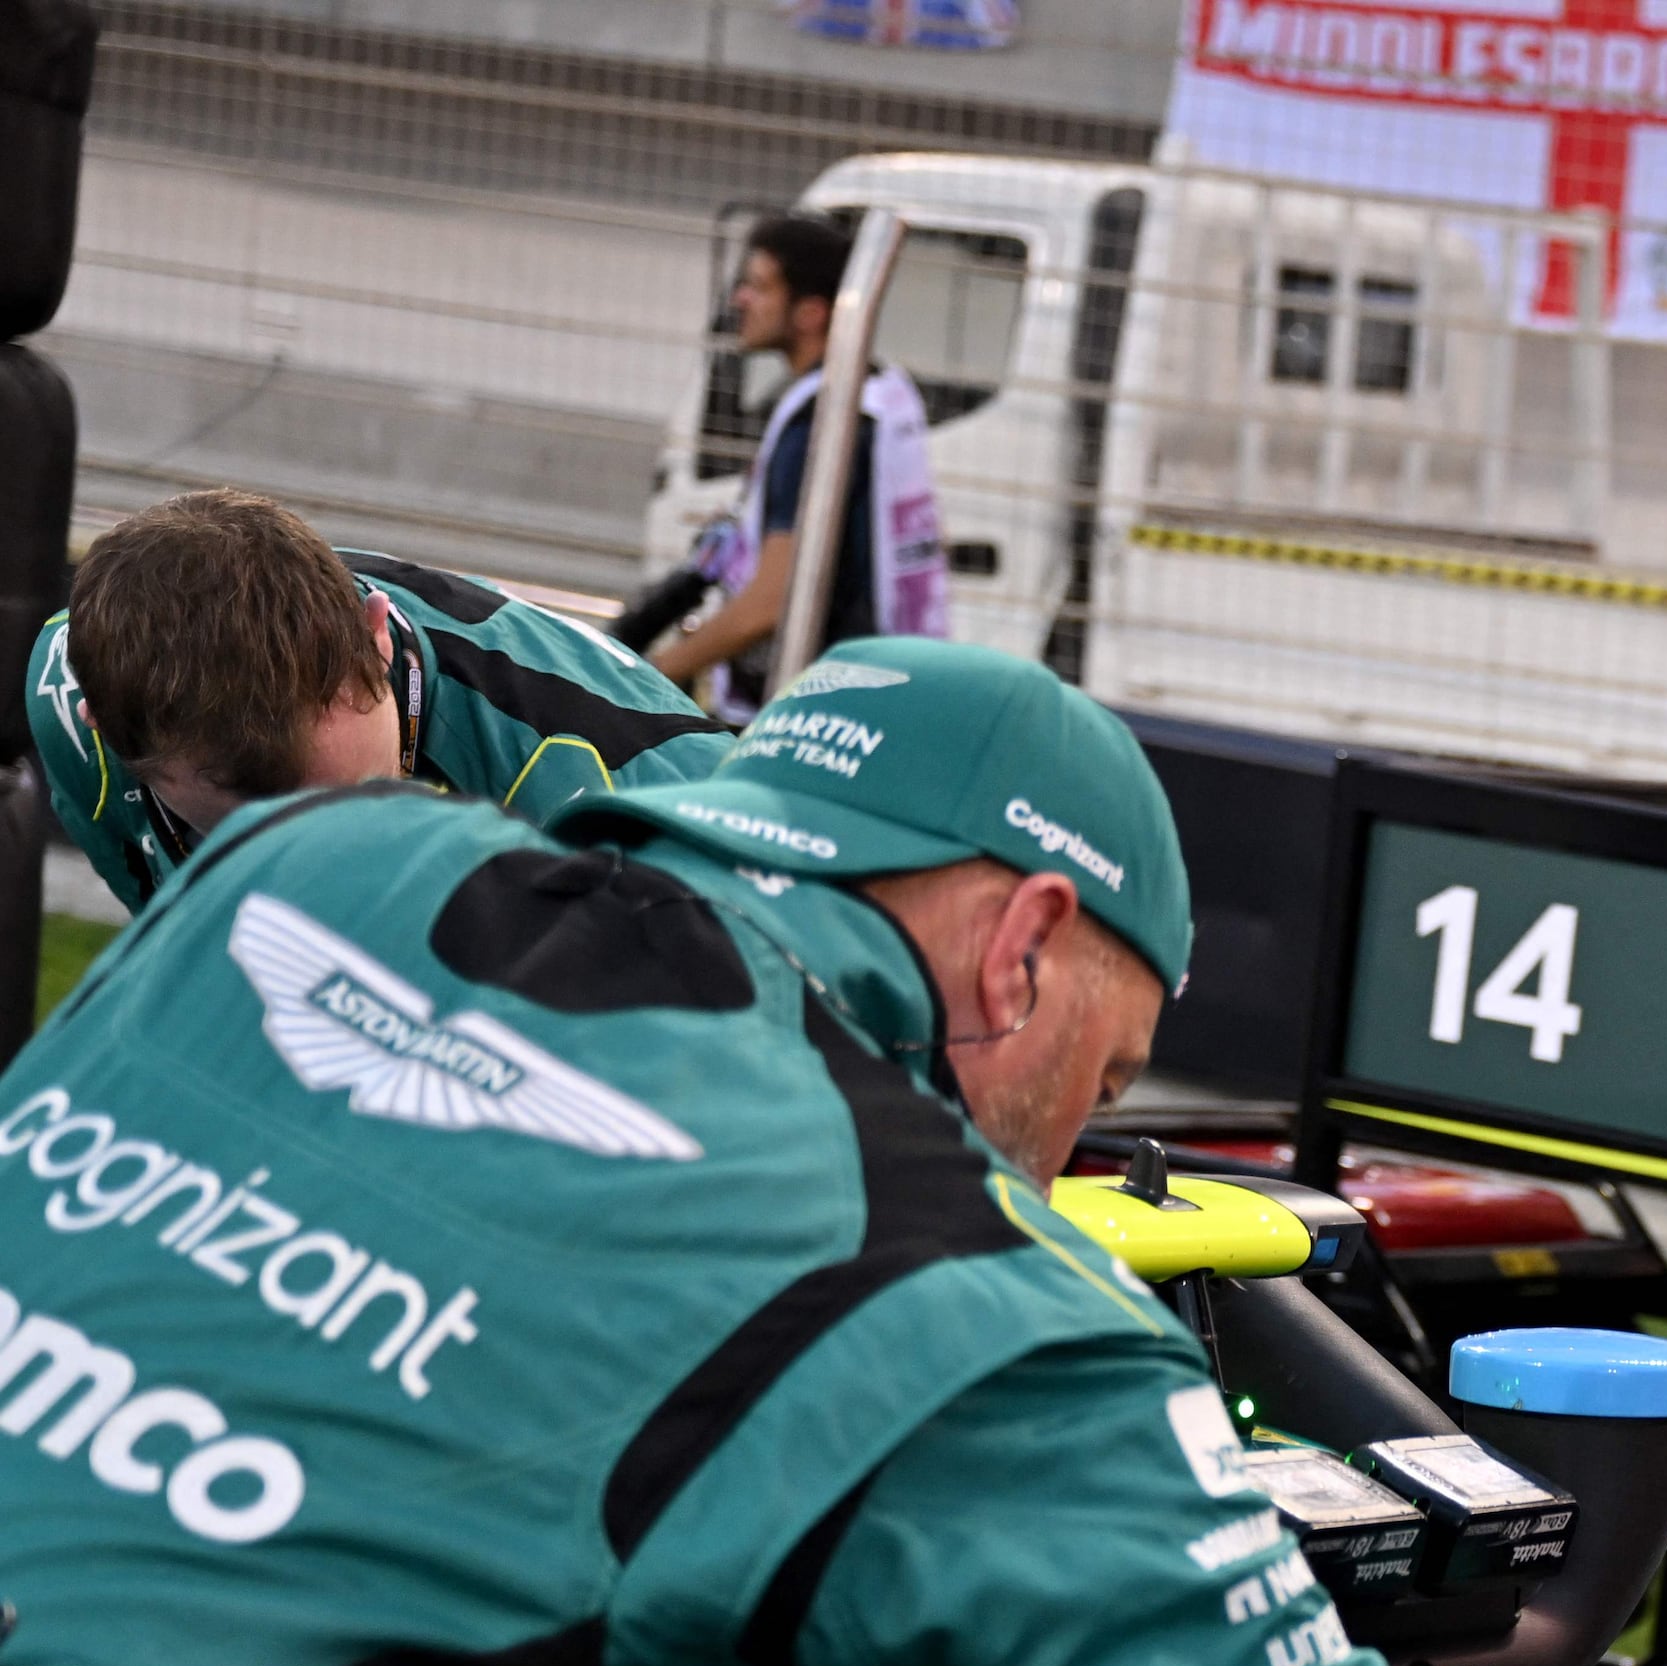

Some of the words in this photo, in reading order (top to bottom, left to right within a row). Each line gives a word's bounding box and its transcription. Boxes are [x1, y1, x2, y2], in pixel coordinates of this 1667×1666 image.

[763, 710, 886, 757] MARTIN
[794, 740, 863, 779] TEAM
[676, 802, 838, 860] aramco
[1416, 884, 1583, 1063] 14
[312, 975, 420, 1057] ASTON
[0, 1086, 479, 1400] cognizant
[0, 1284, 306, 1545] mco
[1352, 1557, 1412, 1585] makita
[1509, 1538, 1564, 1568] makita
